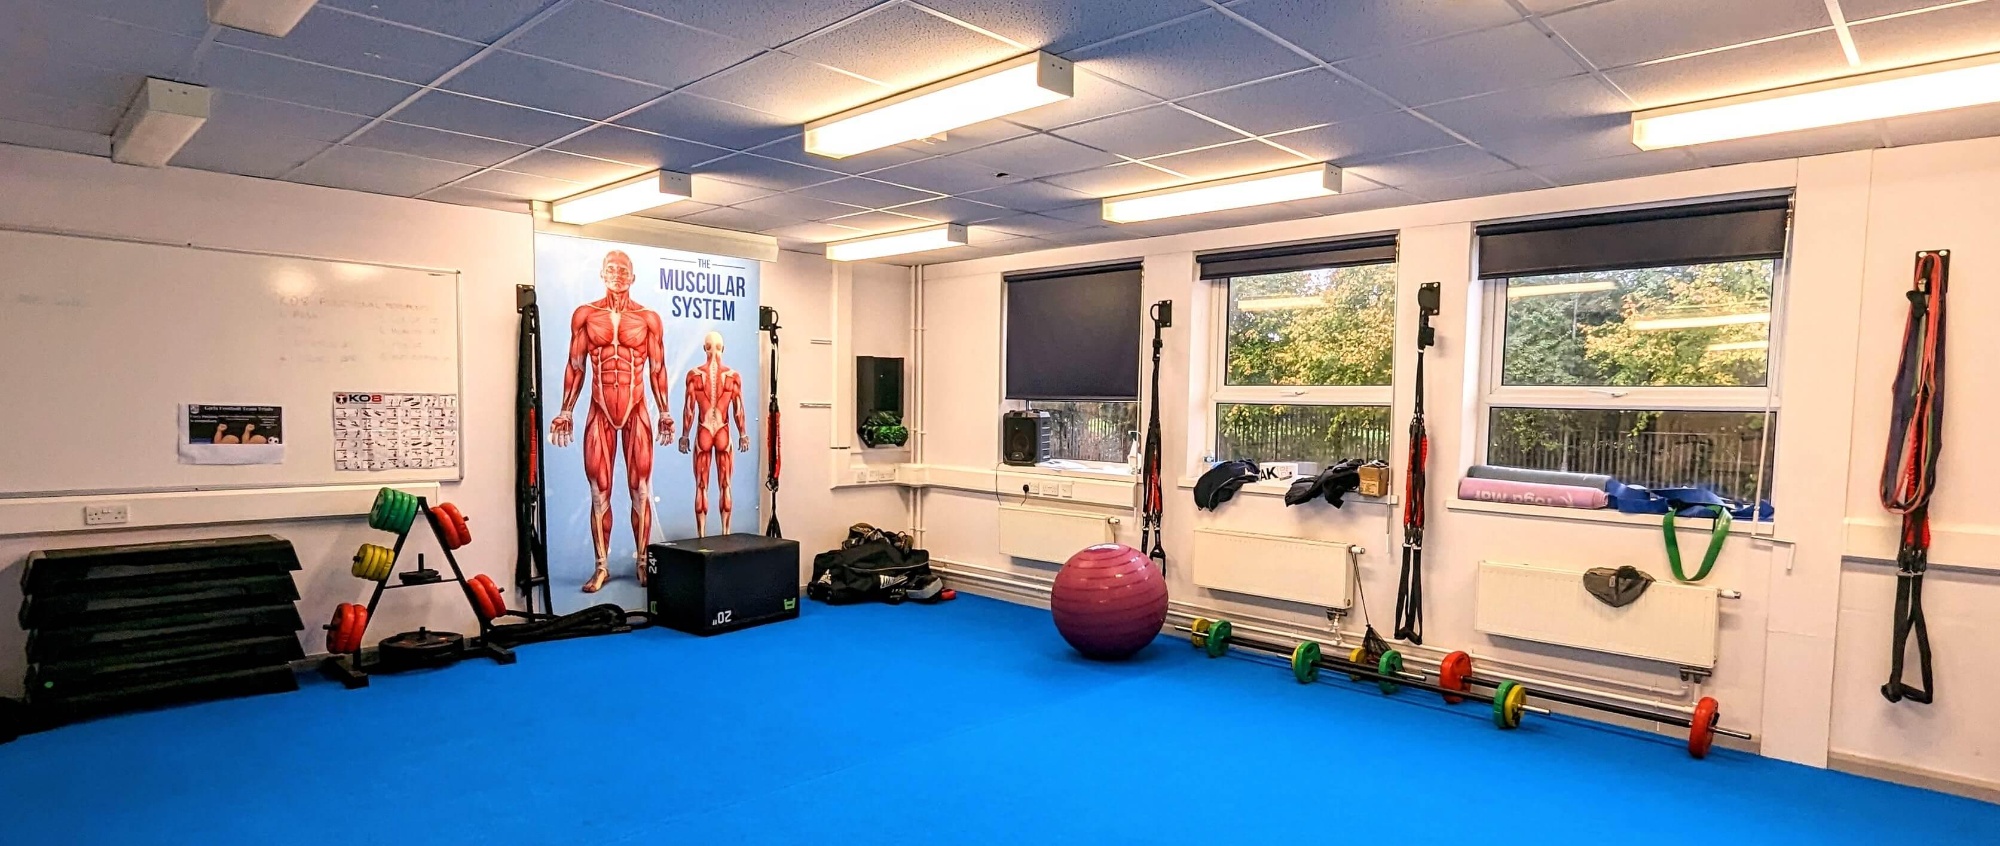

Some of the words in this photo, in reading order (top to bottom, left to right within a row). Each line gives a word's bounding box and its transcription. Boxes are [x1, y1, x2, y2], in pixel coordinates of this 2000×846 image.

[698, 259, 711, 269] THE
[660, 268, 745, 297] MUSCULAR
[672, 296, 735, 321] SYSTEM
[348, 394, 382, 403] KO8
[648, 552, 658, 574] 24"
[712, 610, 733, 626] 20"
